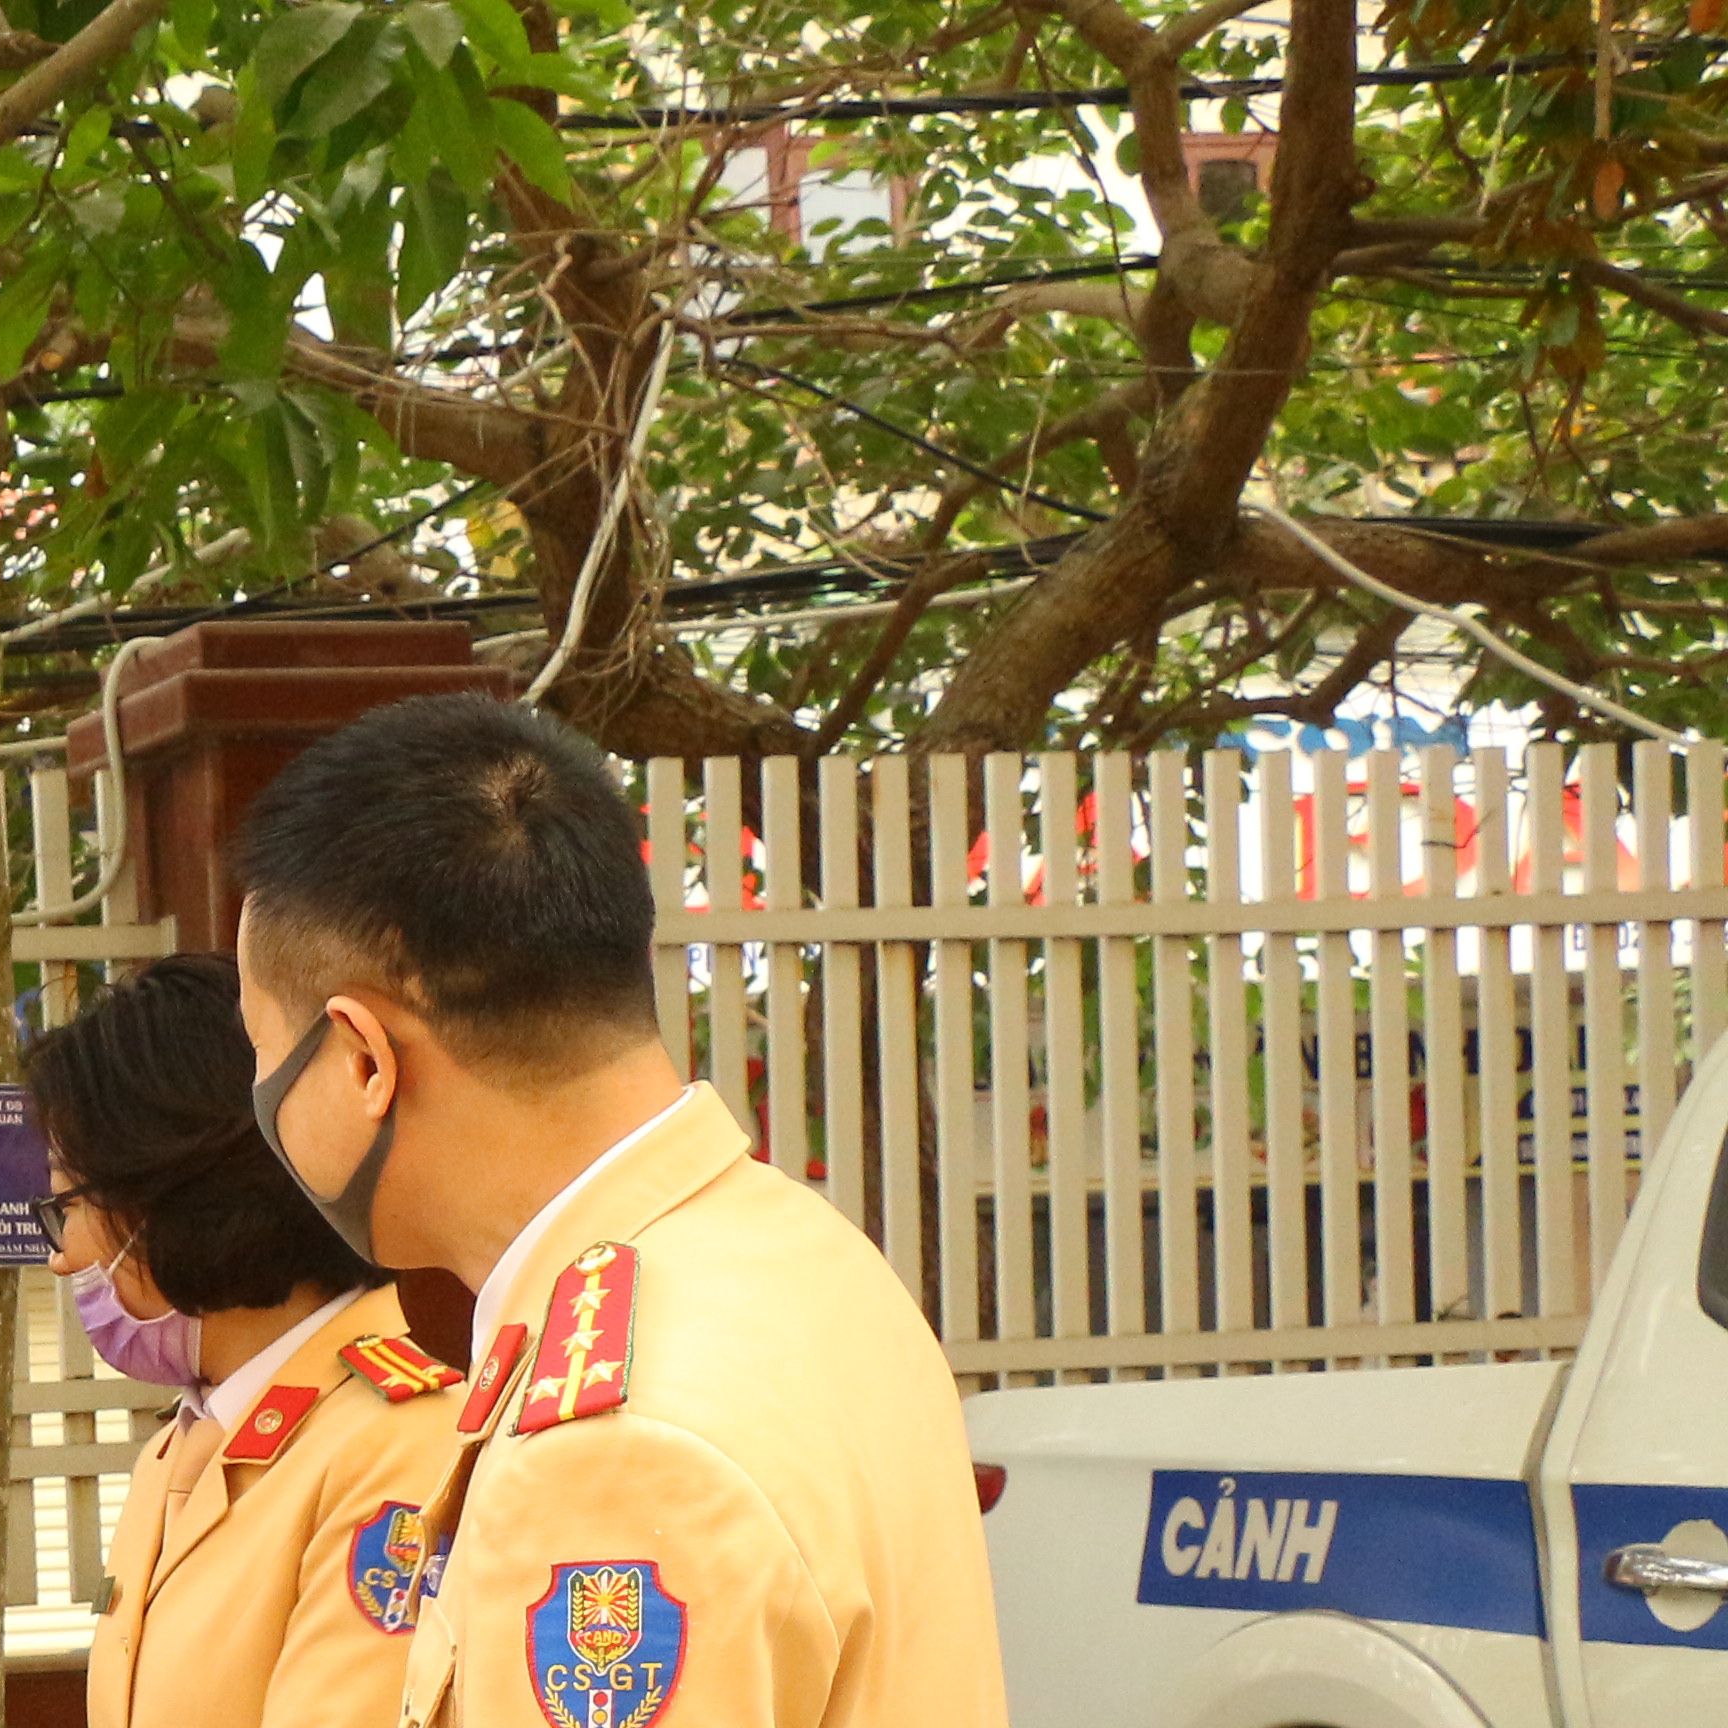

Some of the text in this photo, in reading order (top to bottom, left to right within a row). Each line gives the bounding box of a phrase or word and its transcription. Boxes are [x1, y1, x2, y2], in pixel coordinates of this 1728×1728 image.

[1161, 1477, 1338, 1584] CẢNH
[364, 1566, 398, 1589] CS
[583, 1630, 623, 1646] CAND
